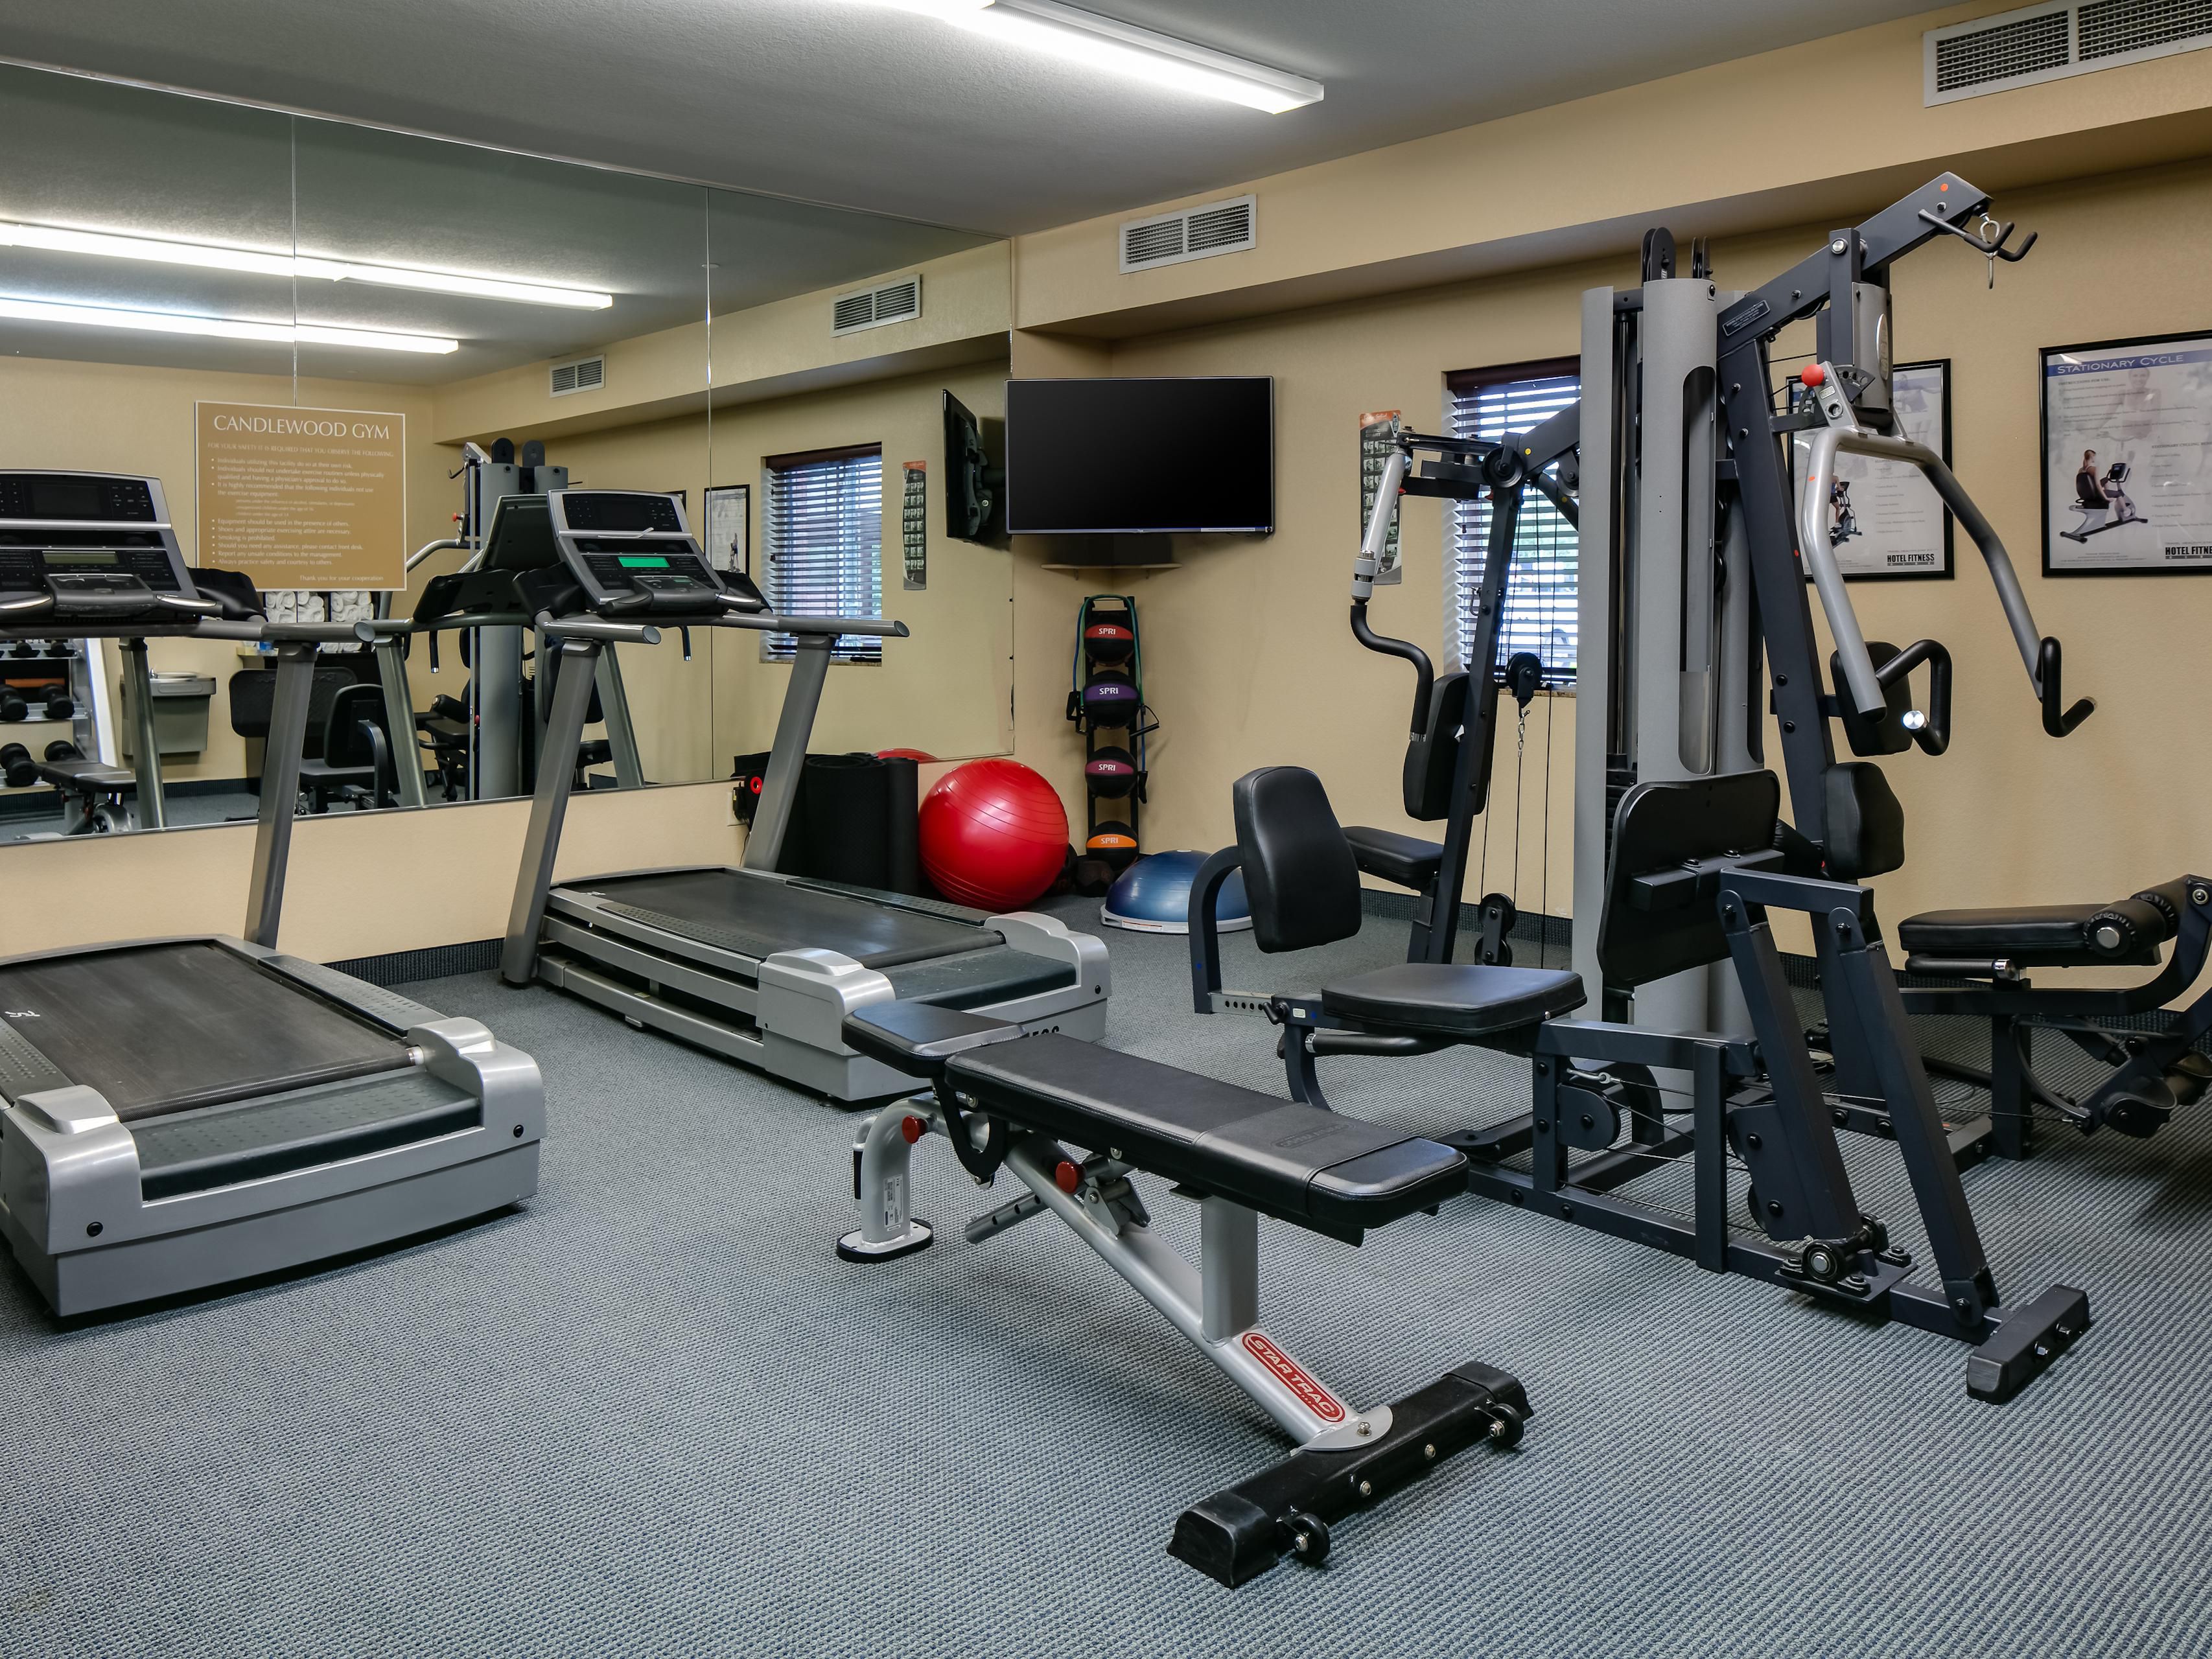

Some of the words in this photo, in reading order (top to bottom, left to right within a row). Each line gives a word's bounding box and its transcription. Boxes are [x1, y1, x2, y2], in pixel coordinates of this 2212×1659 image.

[2058, 360, 2135, 374] STATIONARY
[2140, 355, 2183, 365] CYCLE
[214, 414, 346, 437] CANDLEWOOD
[352, 423, 389, 439] GYM
[1887, 554, 1907, 563] HOTEL
[1908, 553, 1935, 562] FITNESS
[2165, 547, 2189, 555] HOTEL
[1099, 687, 1119, 695] SPRI
[1253, 1340, 1293, 1375] STAR
[1291, 1374, 1336, 1413] TRAC
